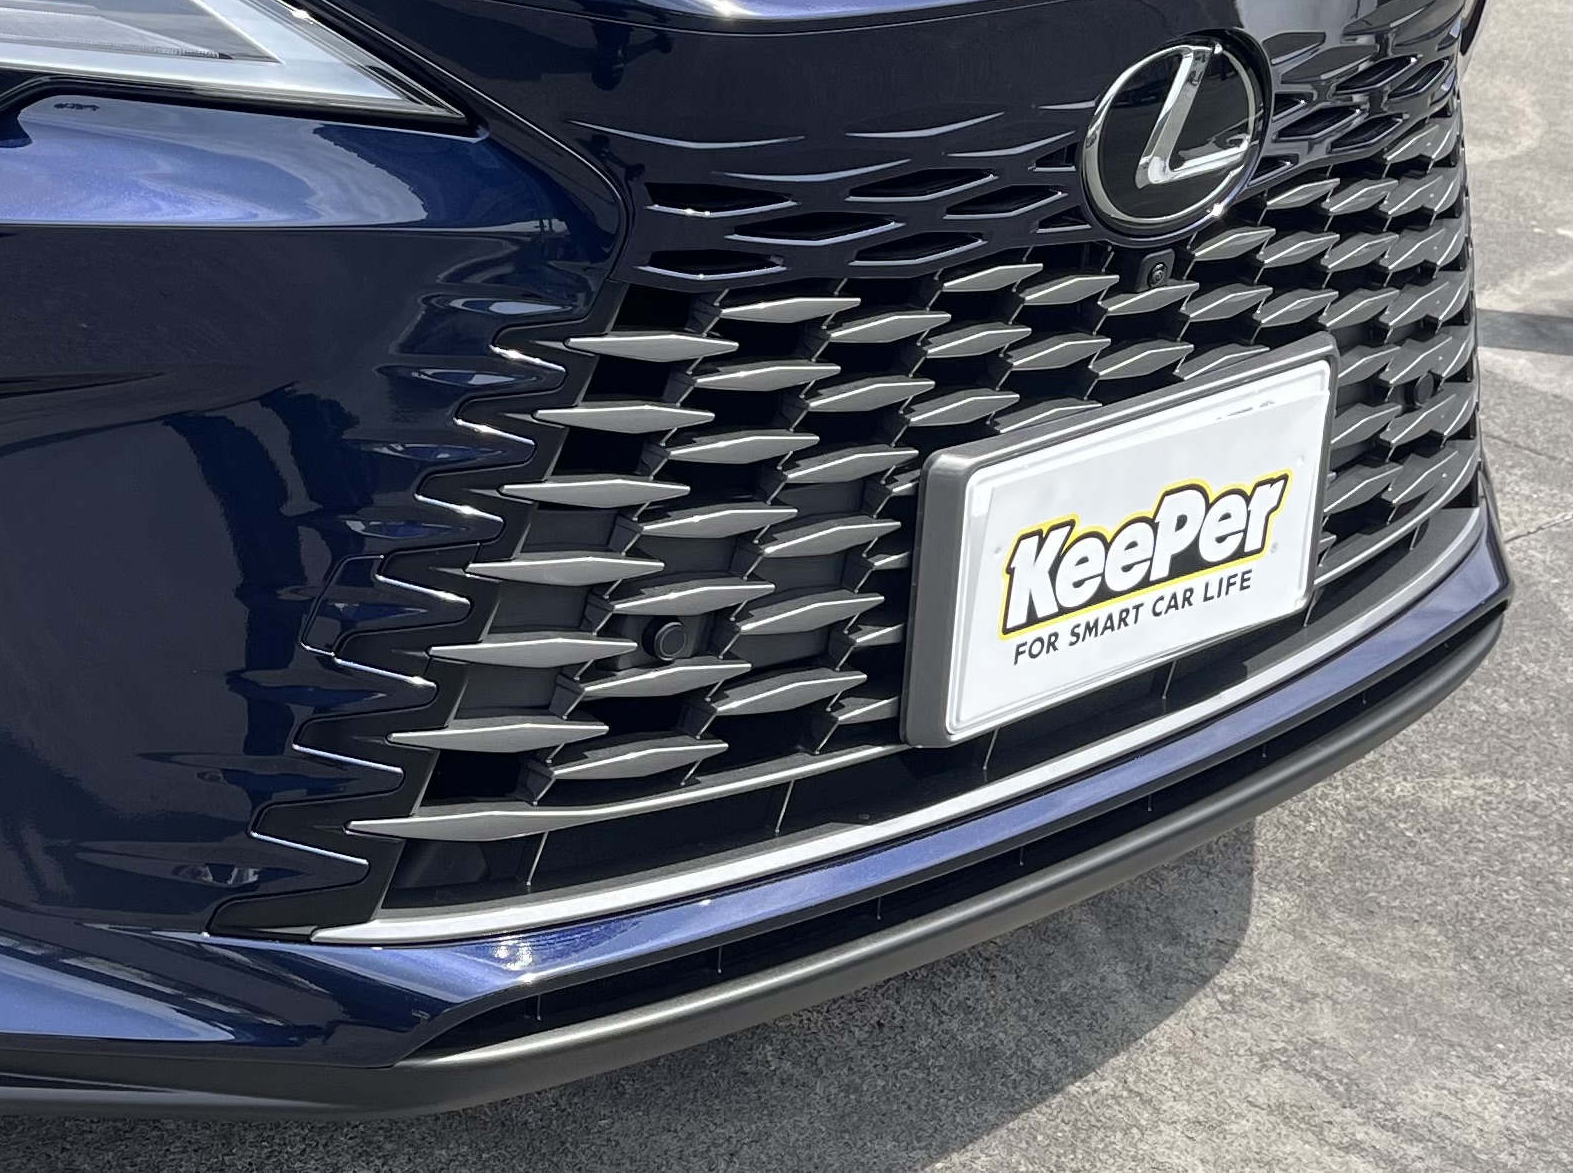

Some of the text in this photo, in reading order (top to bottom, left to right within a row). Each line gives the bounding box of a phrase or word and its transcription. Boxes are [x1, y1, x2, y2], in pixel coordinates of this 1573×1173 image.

[1000, 469, 1291, 638] KeePer
[1013, 570, 1253, 665] FOR SMART CAR LIFE
